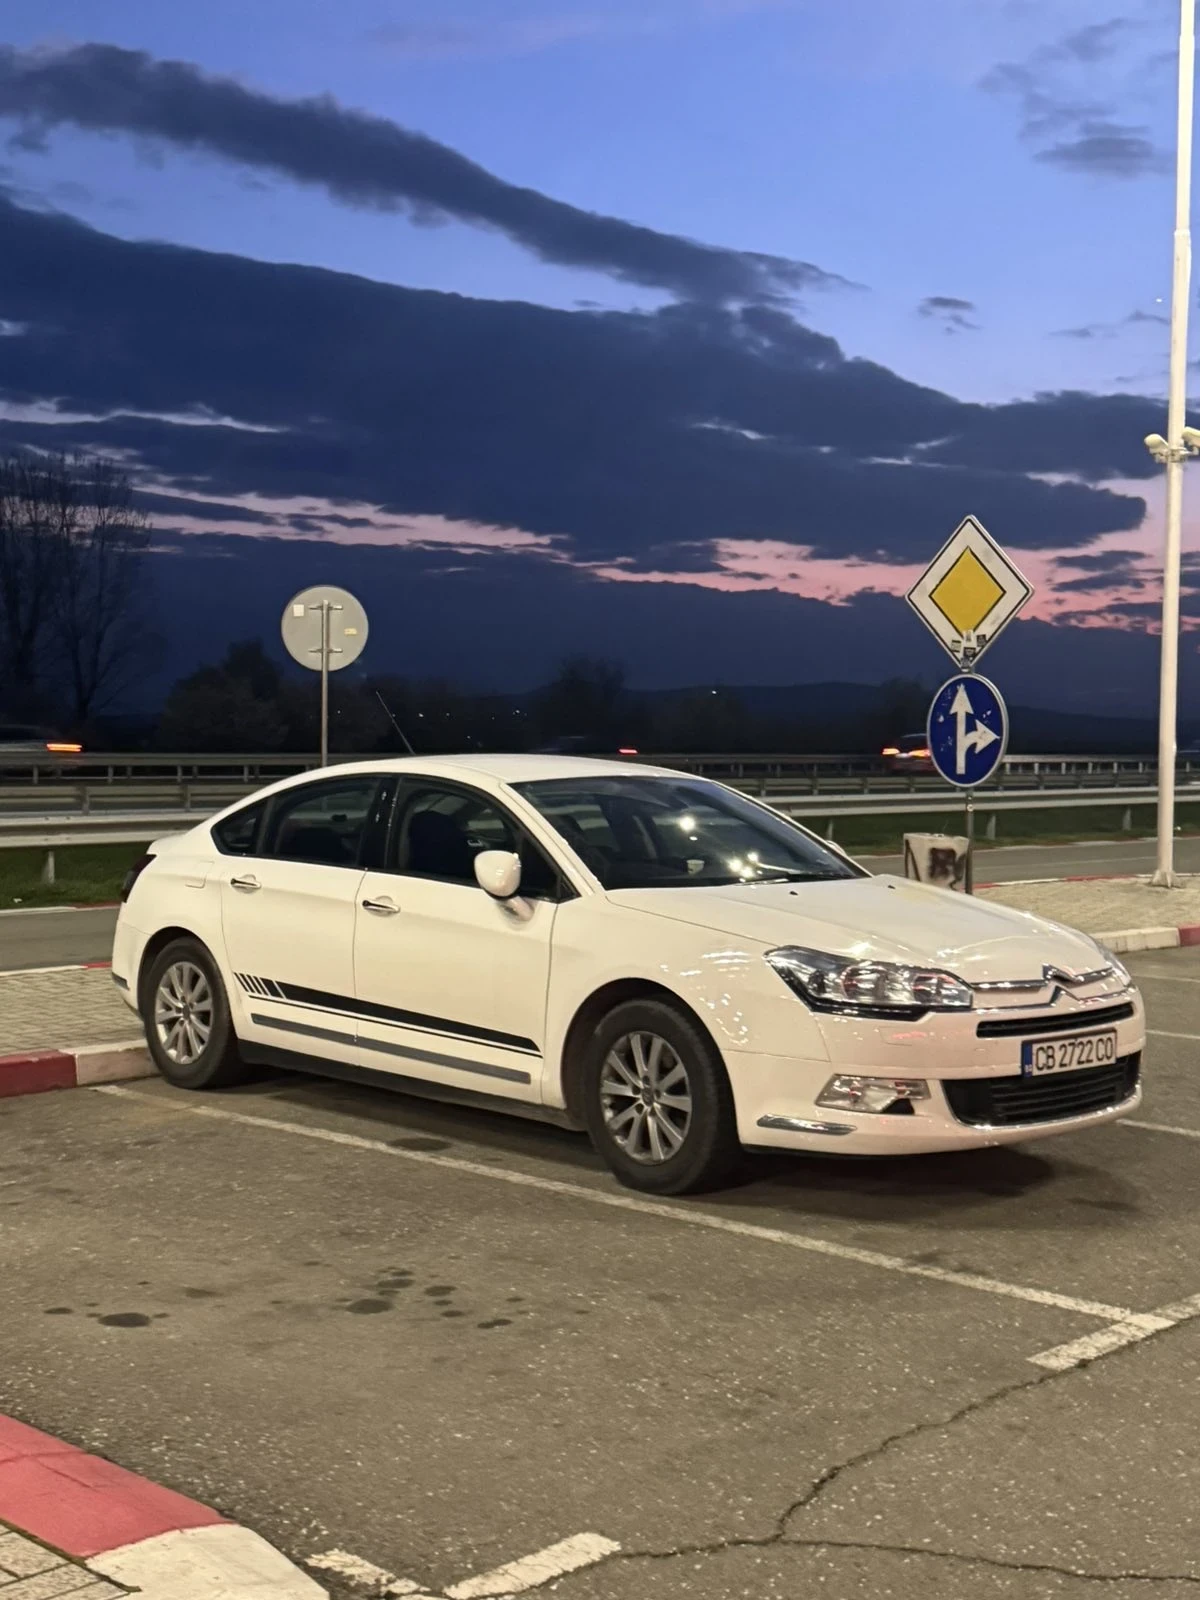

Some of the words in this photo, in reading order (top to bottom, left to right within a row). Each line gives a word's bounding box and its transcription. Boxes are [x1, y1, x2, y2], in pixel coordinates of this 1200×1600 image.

[1035, 1045, 1055, 1071] CB
[1059, 1040, 1093, 1068] 2722
[1095, 1037, 1113, 1062] CO
